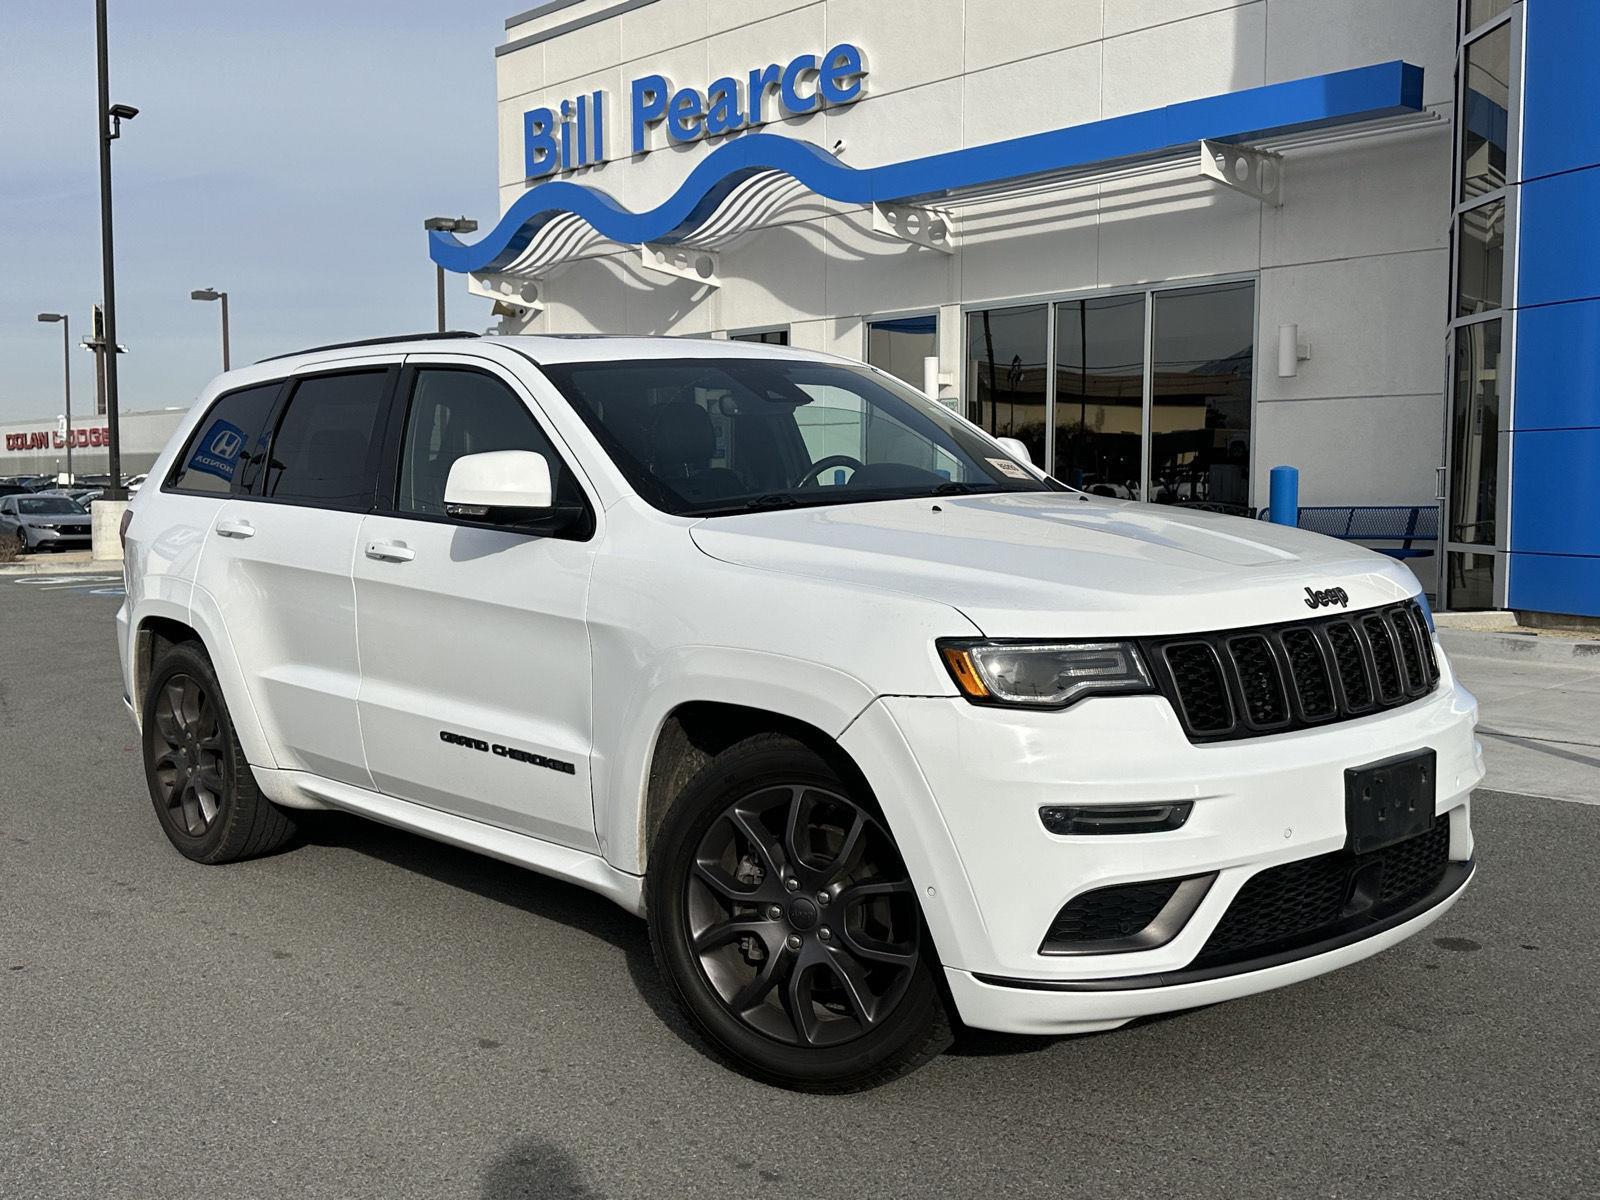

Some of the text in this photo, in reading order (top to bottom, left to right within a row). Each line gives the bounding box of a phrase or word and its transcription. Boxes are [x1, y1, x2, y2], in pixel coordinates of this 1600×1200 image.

[524, 44, 864, 178] Bill Pearce
[6, 431, 49, 451] DOLAN
[1304, 586, 1349, 609] Jeep
[439, 731, 576, 775] GRAND CHEROKEE
